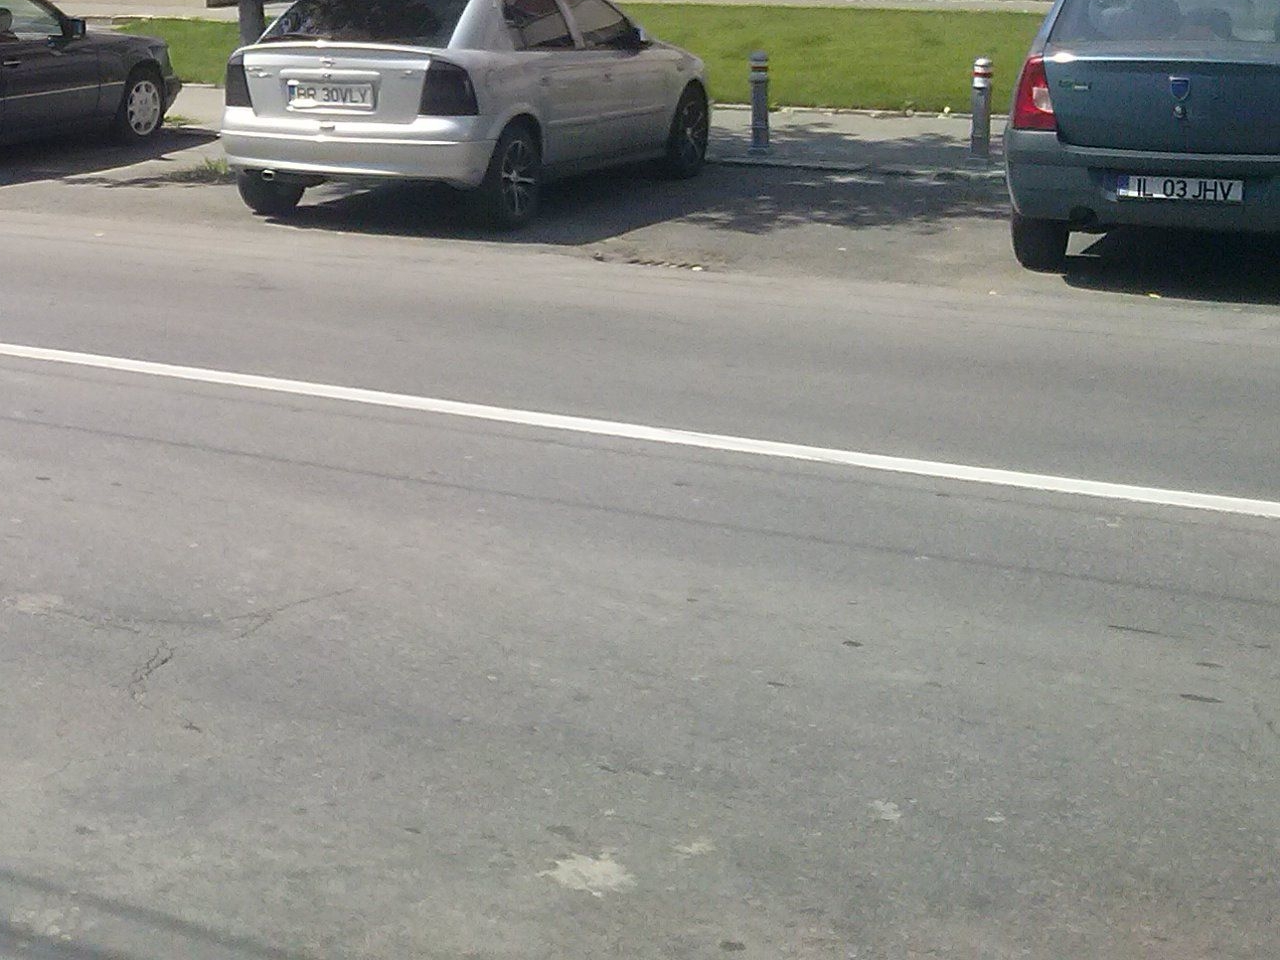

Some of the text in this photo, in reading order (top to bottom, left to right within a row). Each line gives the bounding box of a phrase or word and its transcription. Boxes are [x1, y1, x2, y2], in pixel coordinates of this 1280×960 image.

[322, 87, 368, 103] 30VLY
[1163, 179, 1188, 197] 03
[1192, 182, 1233, 201] JHV
